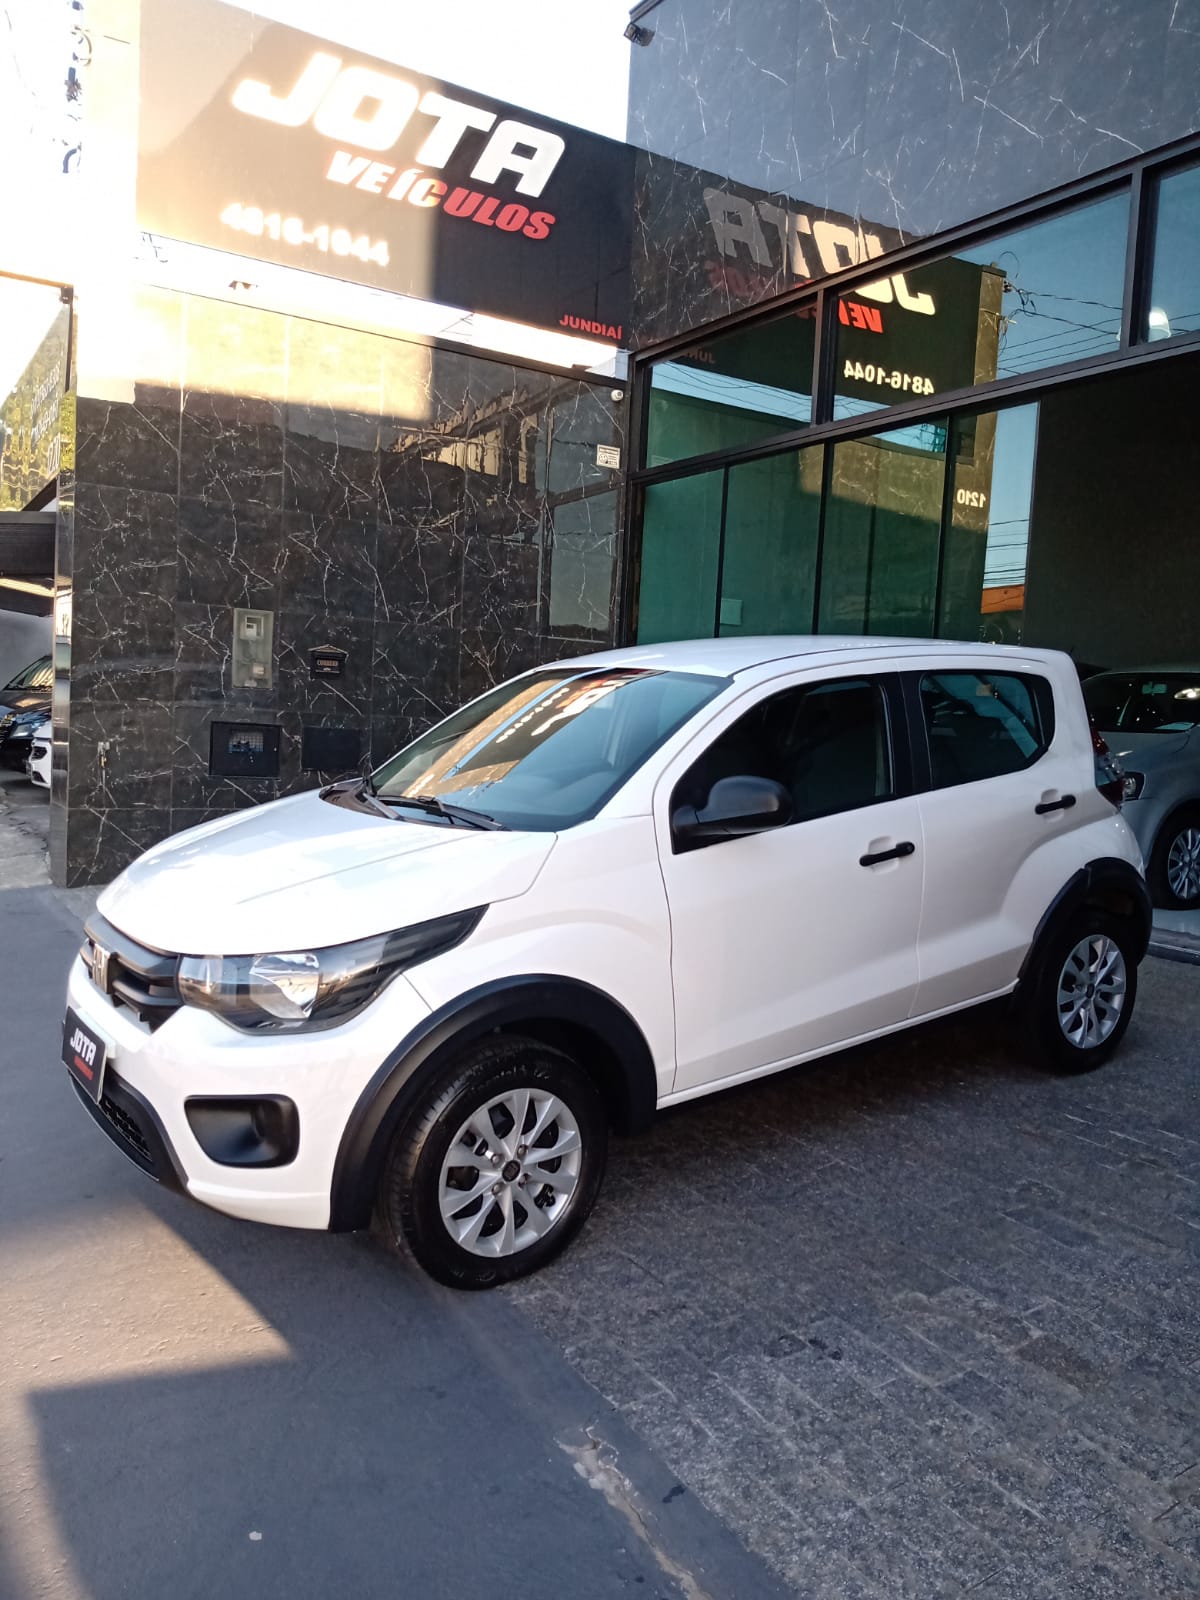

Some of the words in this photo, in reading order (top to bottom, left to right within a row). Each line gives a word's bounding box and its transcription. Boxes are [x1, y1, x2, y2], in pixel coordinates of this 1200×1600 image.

[231, 51, 566, 198] JOTA
[325, 150, 556, 240] VEÍCULOS
[559, 313, 623, 340] JUNDIAÍ
[69, 1027, 97, 1067] JOTA
